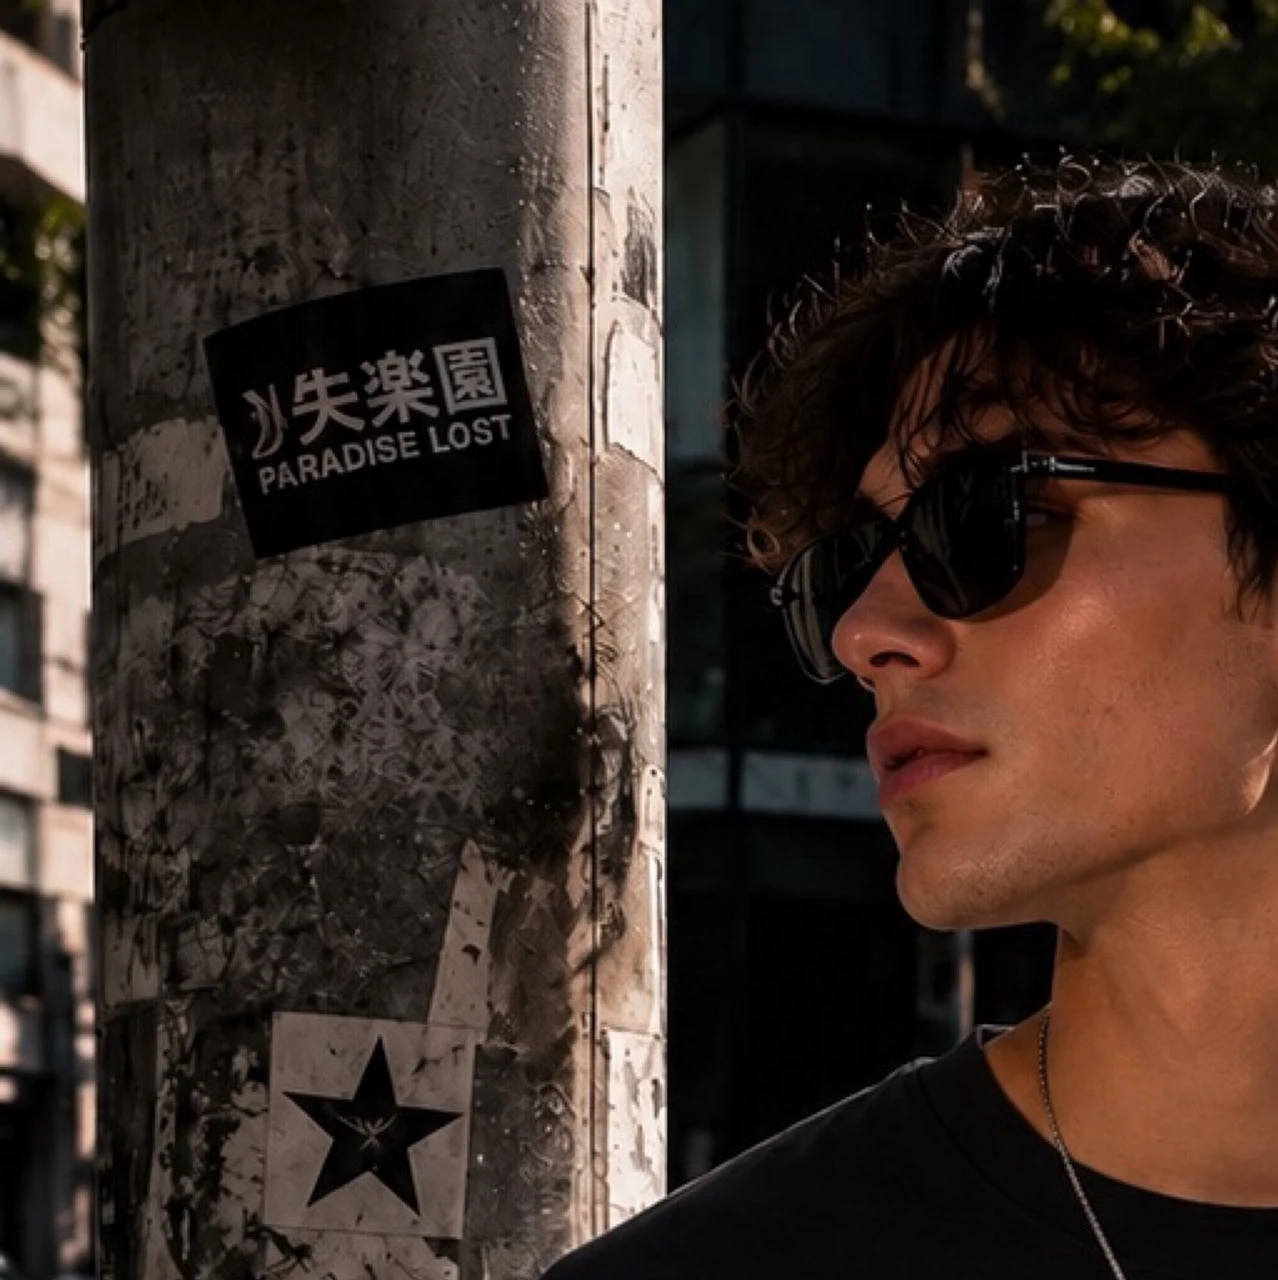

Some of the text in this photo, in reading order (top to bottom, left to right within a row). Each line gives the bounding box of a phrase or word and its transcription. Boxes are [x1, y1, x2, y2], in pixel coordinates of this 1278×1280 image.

[292, 337, 508, 445] 失楽園
[259, 414, 512, 494] PARADISE LOST
